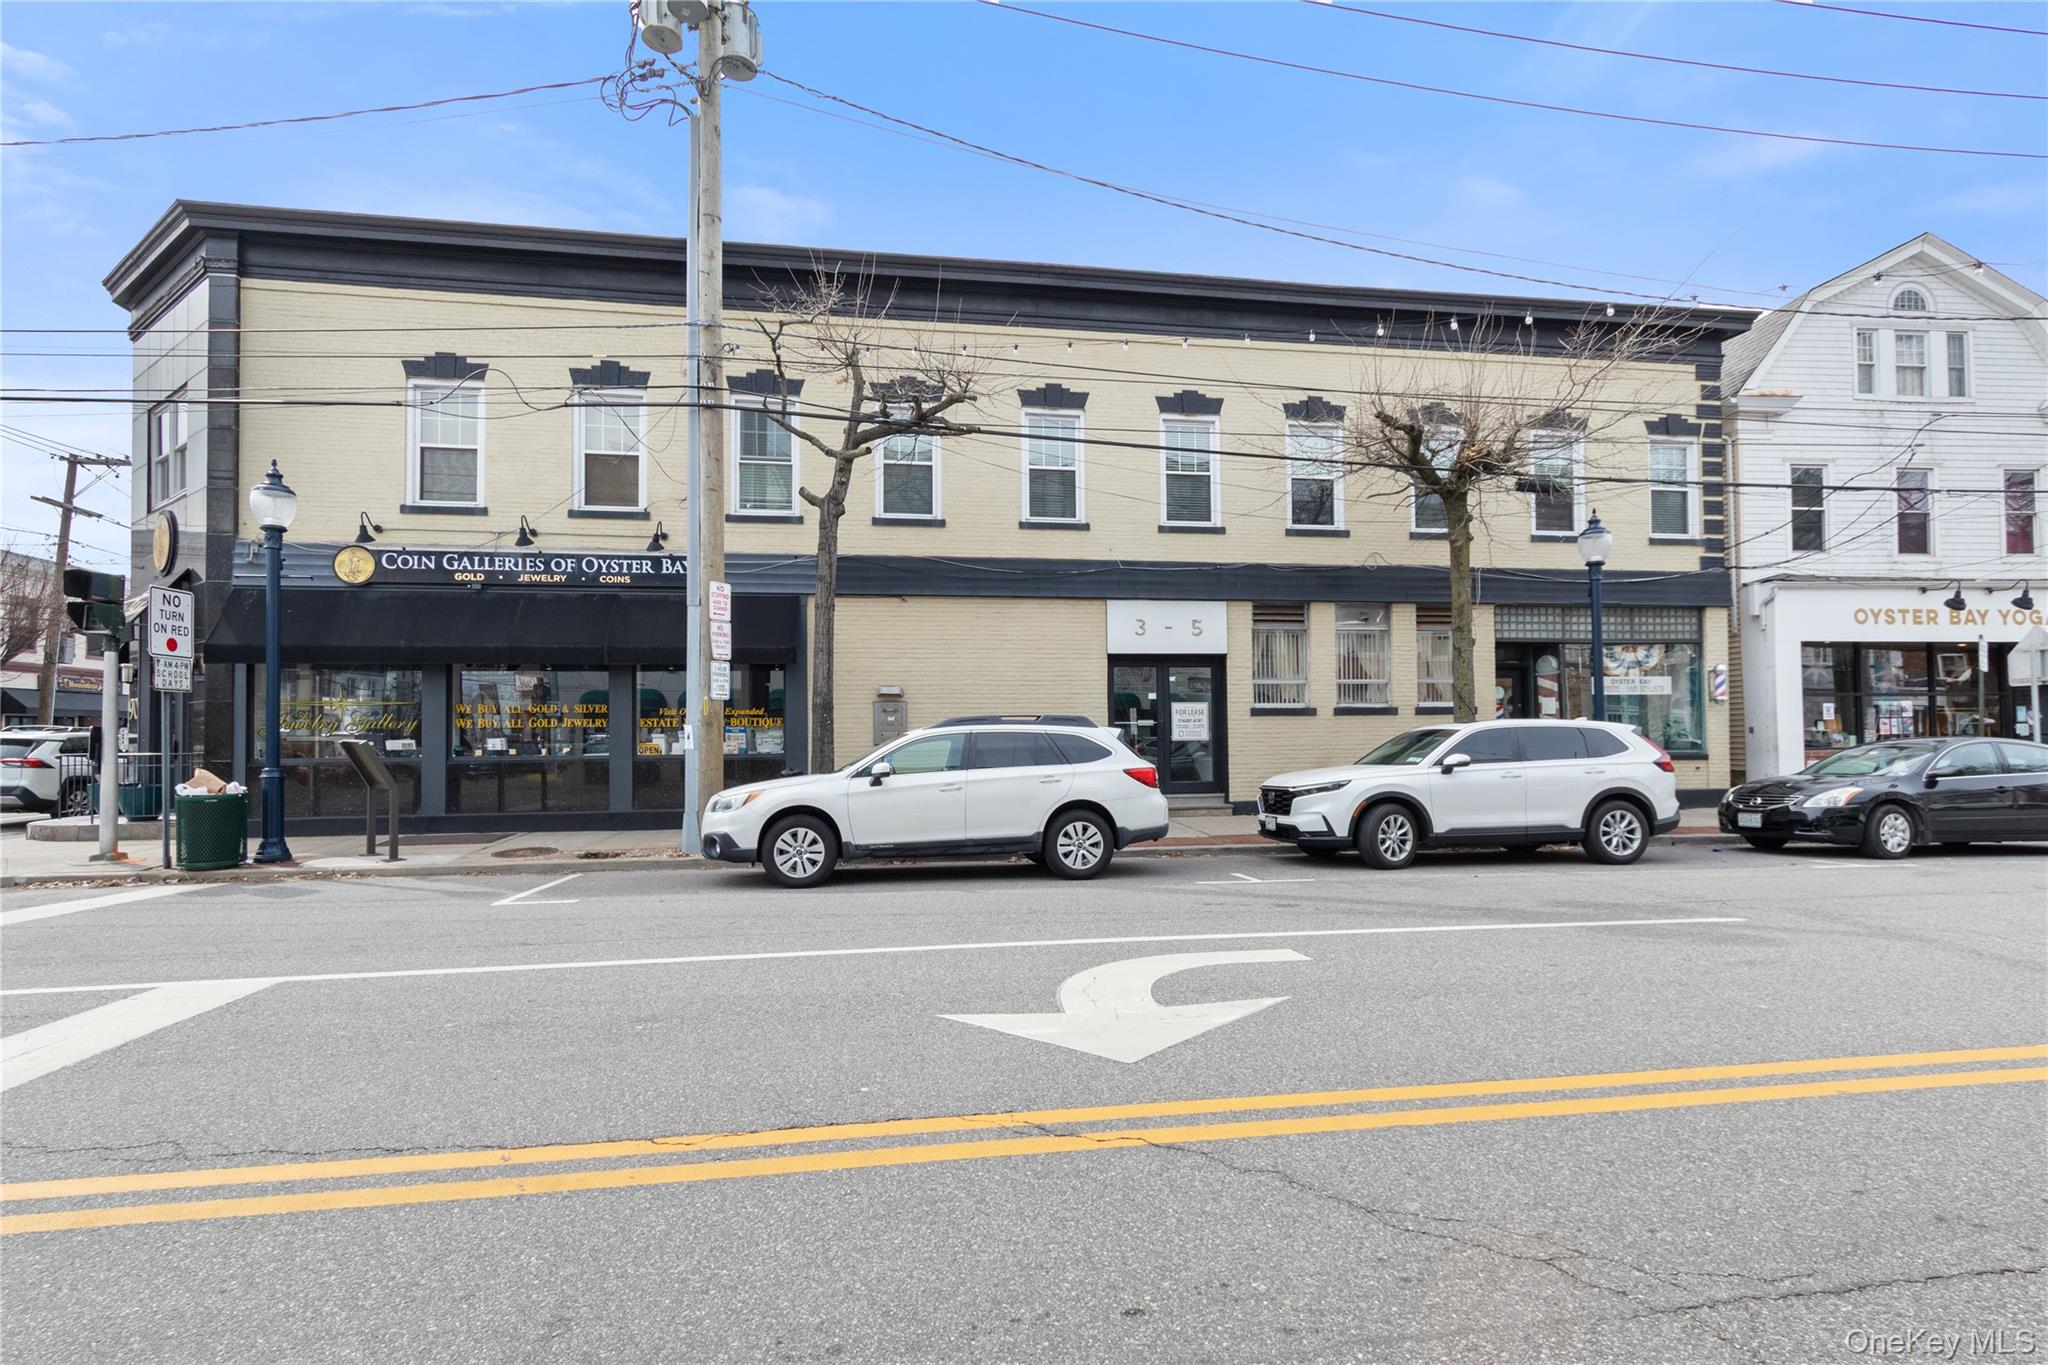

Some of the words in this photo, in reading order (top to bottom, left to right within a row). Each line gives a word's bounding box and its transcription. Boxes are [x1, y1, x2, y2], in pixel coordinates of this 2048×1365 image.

[381, 552, 435, 570] COIN
[442, 553, 545, 572] GALLERIES
[550, 557, 576, 573] OF
[581, 556, 655, 574] OYSTER
[454, 572, 485, 581] GOLD
[517, 573, 567, 583] JEWELRY
[599, 575, 631, 584] COINS
[162, 593, 181, 608] NO
[159, 608, 185, 622] TURN
[1853, 607, 1939, 625] OYSTER
[1949, 608, 1990, 625] BAY
[1998, 608, 2048, 625] YOG
[153, 622, 167, 634] ON
[171, 625, 190, 637] RED
[1135, 618, 1146, 636] 3
[1191, 619, 1203, 636] 5
[156, 669, 189, 680] SCHOOL
[162, 678, 184, 688] DAYS
[455, 704, 472, 714] WE
[477, 704, 500, 714] BUY
[504, 704, 524, 714] ALL
[528, 704, 558, 714] GOLD
[562, 704, 570, 714] &
[574, 704, 609, 714] SILVER
[659, 707, 677, 716] Visit
[724, 707, 765, 718] Expanded
[1175, 708, 1187, 716] FOR
[1187, 708, 1205, 716] LEASE
[344, 710, 419, 735] Gallery
[455, 718, 473, 728] WE
[477, 718, 500, 728] BUY
[504, 718, 525, 728] ALL
[528, 717, 558, 728] GOLD
[561, 718, 609, 729] JEWELRY
[640, 718, 680, 728] ESTATE
[730, 717, 784, 729] BOUTIQUE
[639, 746, 659, 754] OPEN
